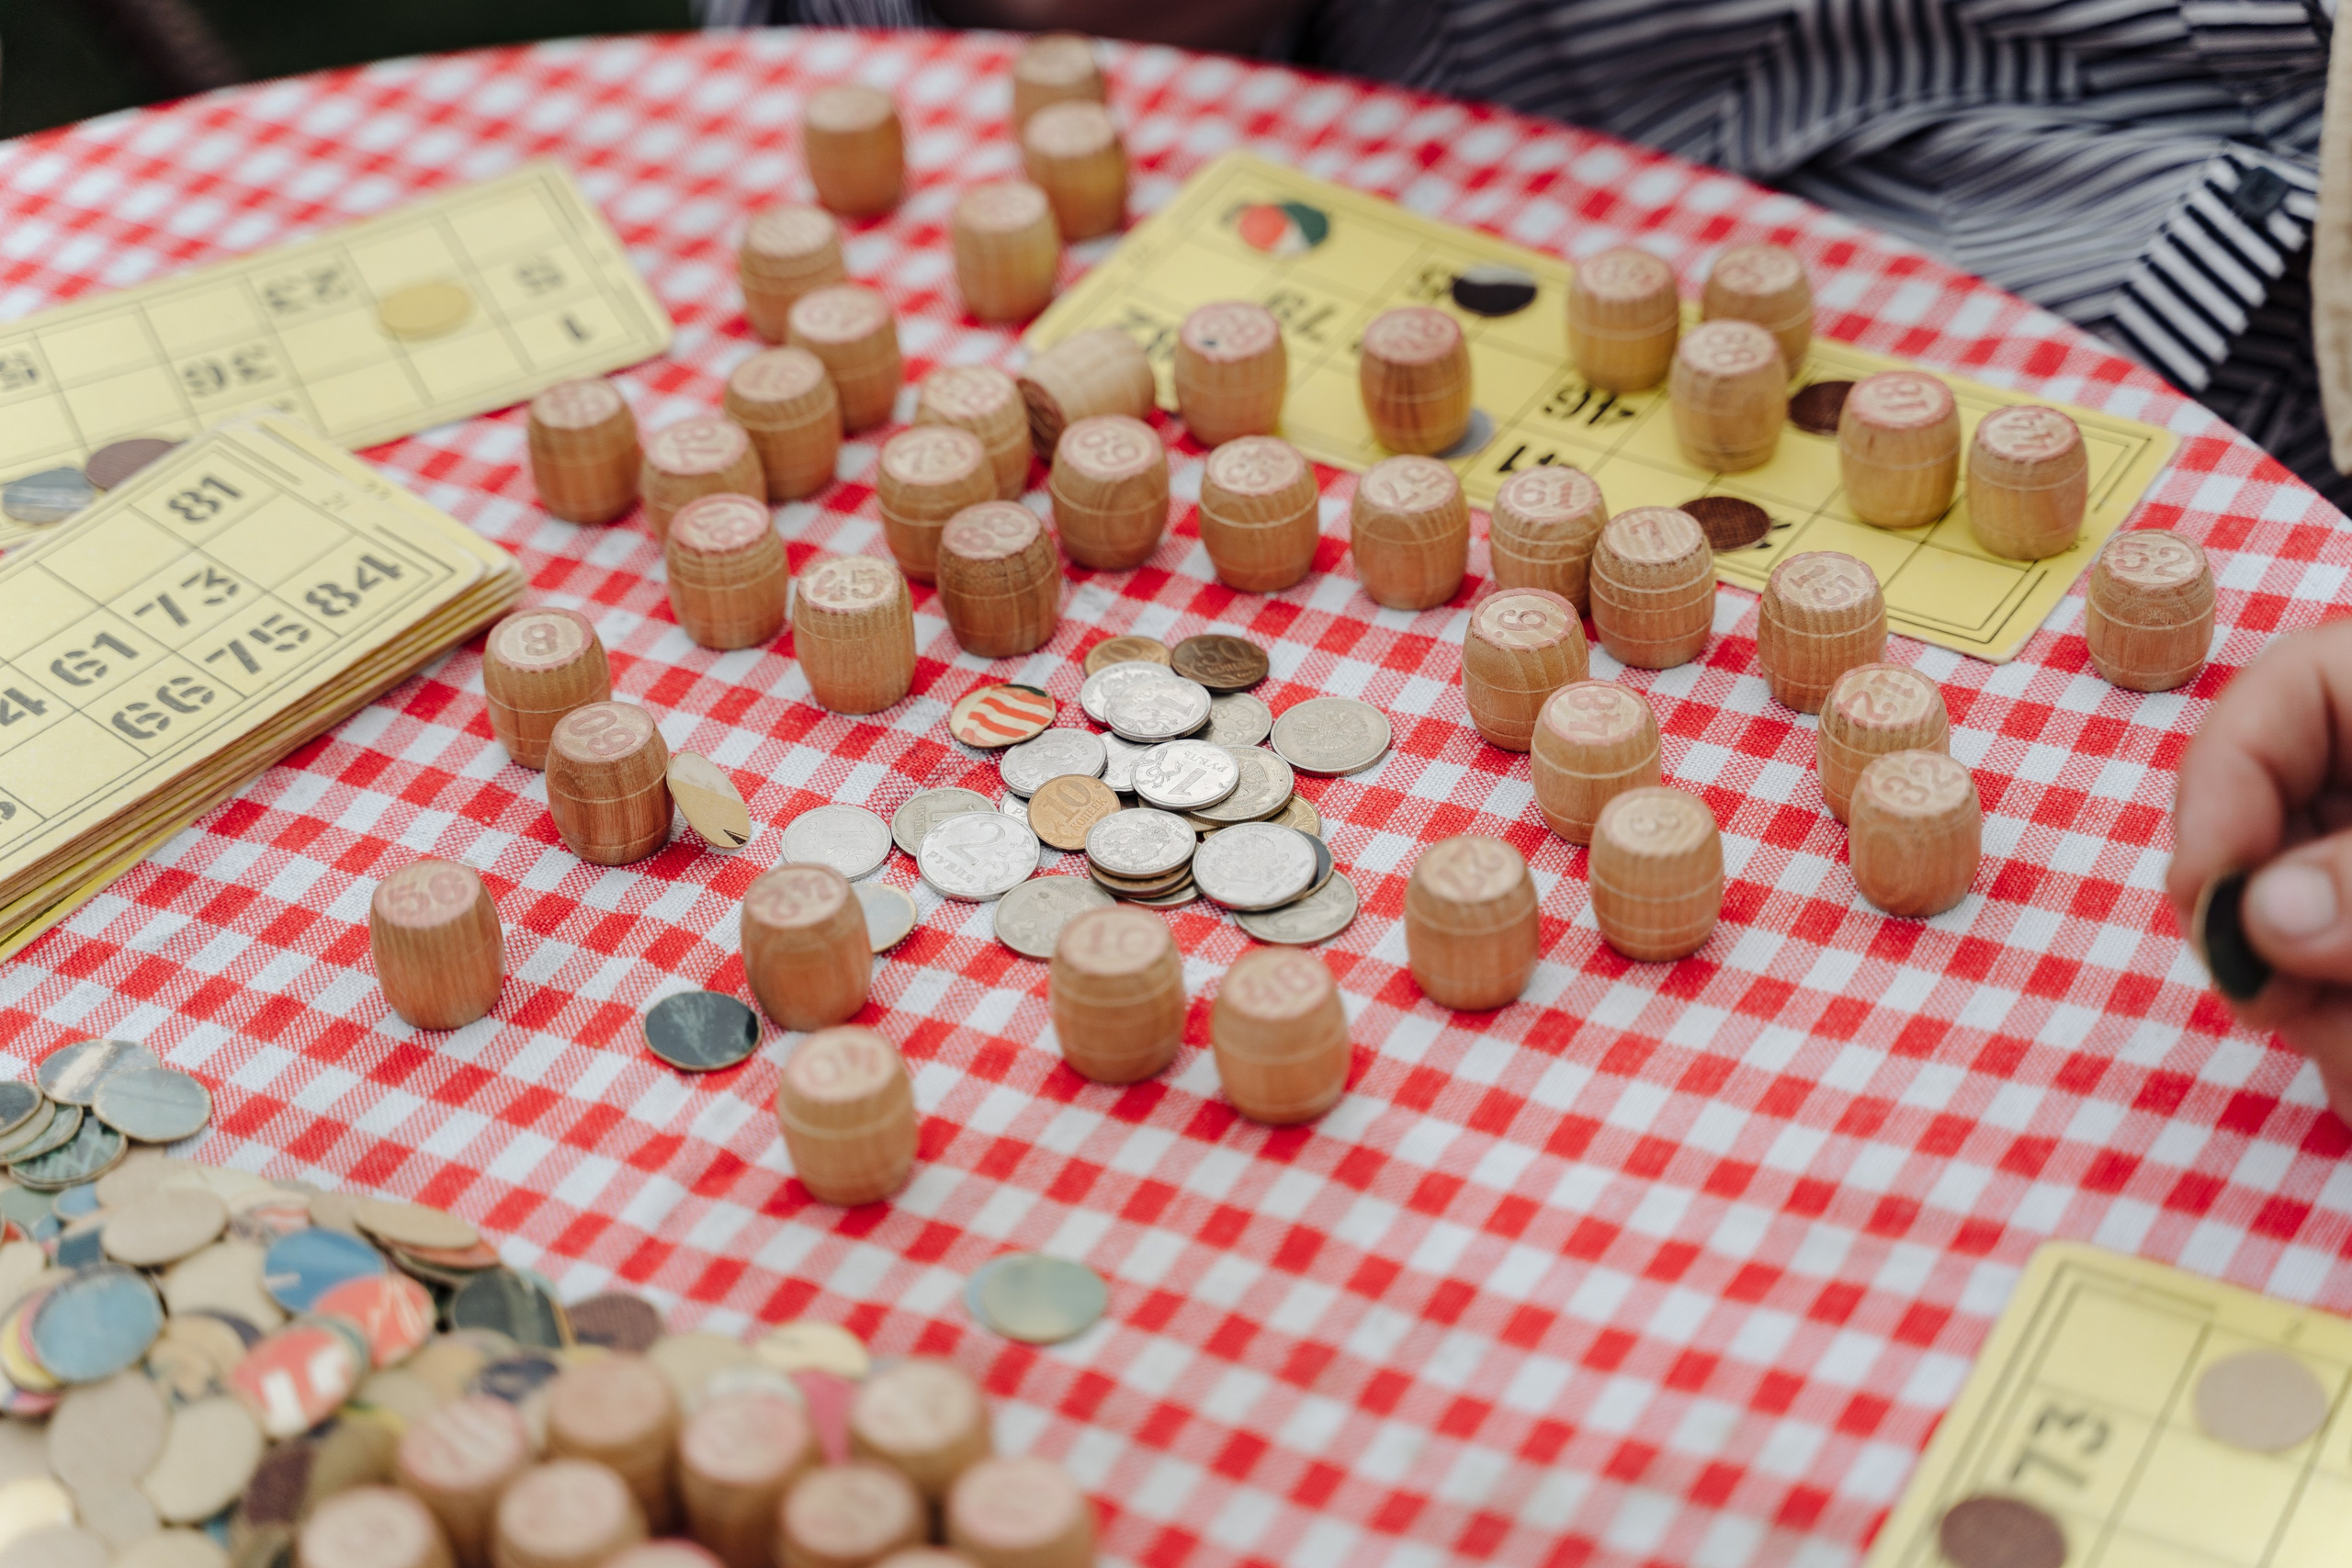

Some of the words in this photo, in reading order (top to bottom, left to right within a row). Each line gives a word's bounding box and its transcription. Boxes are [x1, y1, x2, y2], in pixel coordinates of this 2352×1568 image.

[2000, 413, 2055, 455] 44
[168, 473, 245, 524] 81
[1390, 464, 1448, 505] 57
[1629, 518, 1666, 552] 7
[2112, 540, 2184, 577] 52
[134, 568, 241, 627] 73
[306, 553, 405, 617] 84
[810, 567, 883, 603] 45
[1787, 564, 1853, 606] 15
[51, 632, 141, 685] 61
[205, 614, 311, 675] 75
[522, 621, 558, 657] 8
[112, 676, 216, 740] 66
[1568, 687, 1621, 737] 48
[1841, 672, 1917, 721] 12
[569, 709, 637, 756] 60
[1168, 768, 1207, 795] 1
[1183, 750, 1229, 773] РУБЛЬ
[1883, 759, 1965, 806] 32
[1043, 781, 1091, 823] 10
[1071, 795, 1107, 830] КОПЕЕК
[945, 821, 1005, 865] 2
[926, 852, 976, 884] РУБЛЯ
[387, 872, 469, 918] 56
[1084, 922, 1155, 958] 10
[2009, 1402, 2109, 1490] 73
